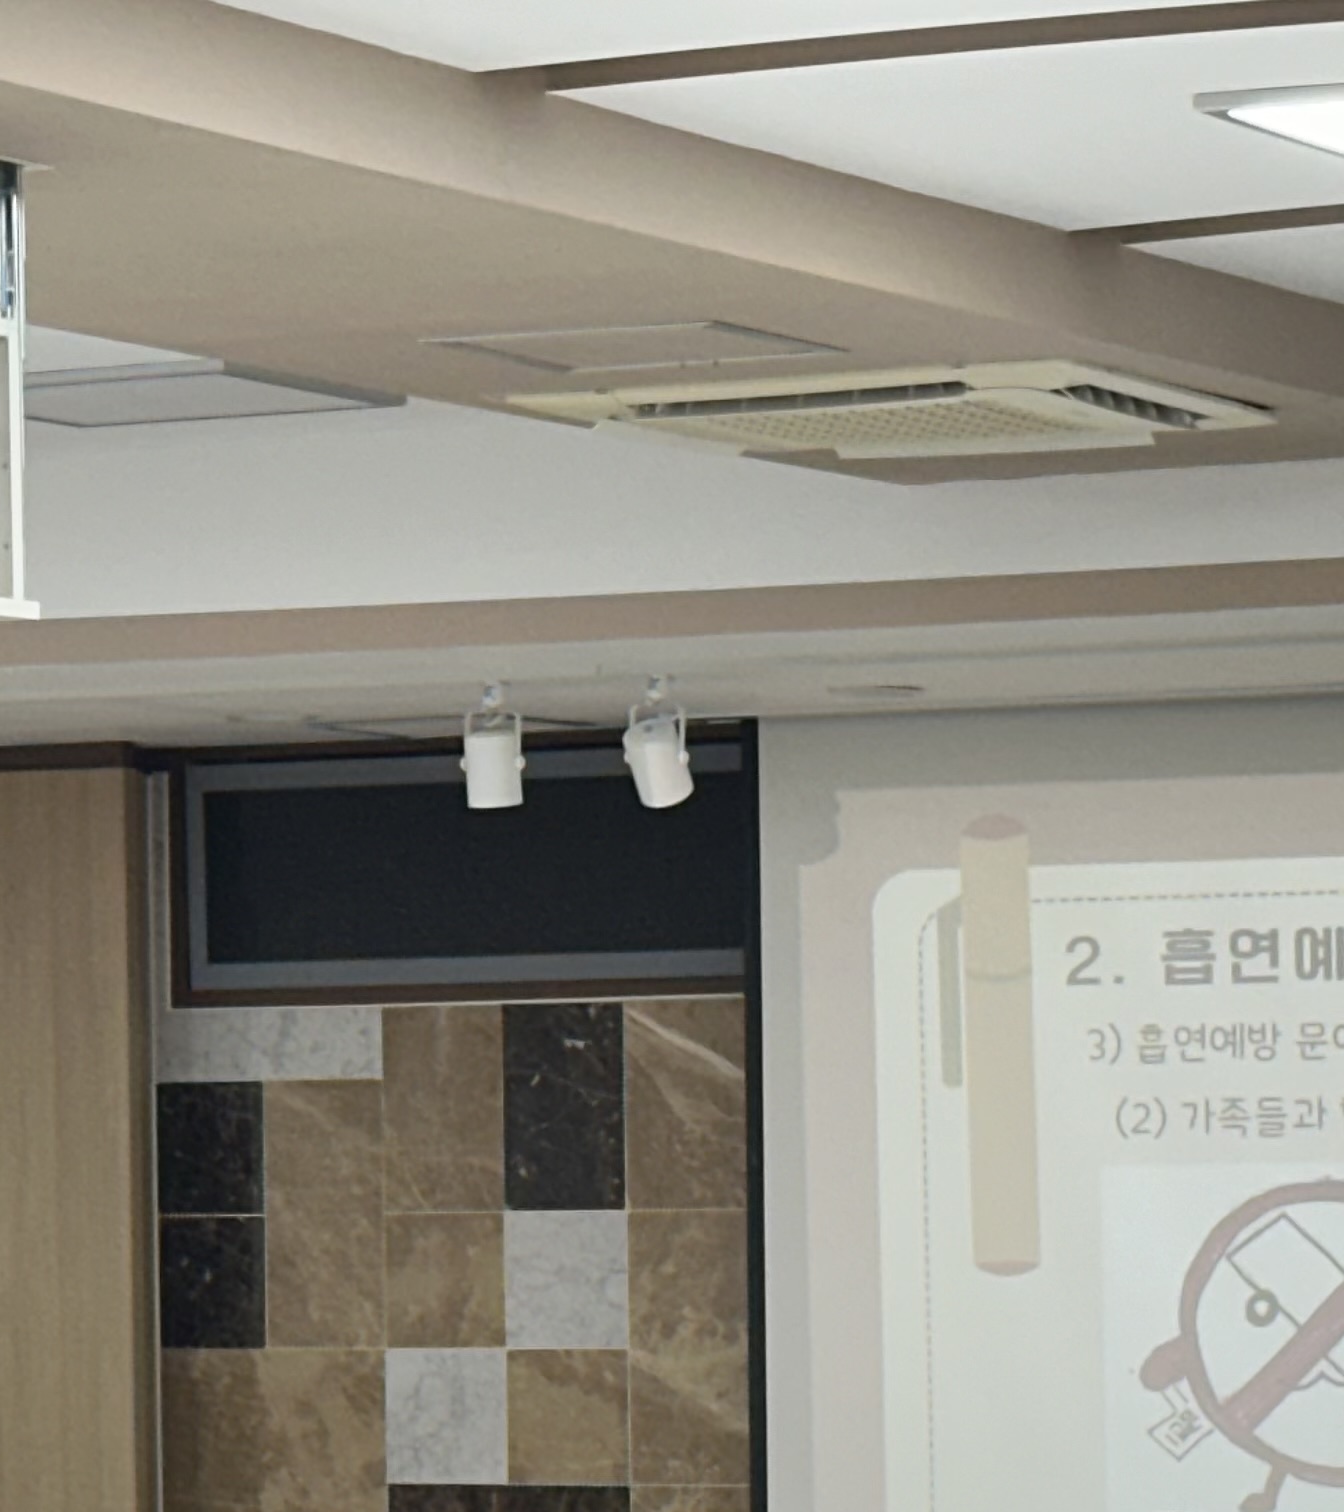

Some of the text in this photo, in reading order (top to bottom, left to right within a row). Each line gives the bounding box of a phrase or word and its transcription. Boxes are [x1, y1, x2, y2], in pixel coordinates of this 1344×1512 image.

[1065, 935, 1125, 986] 2.
[1087, 1022, 1123, 1066] 3)
[1137, 1021, 1282, 1065] 흡연예방
[1115, 1096, 1168, 1141] (2)
[1181, 1096, 1328, 1139] 가족들과
